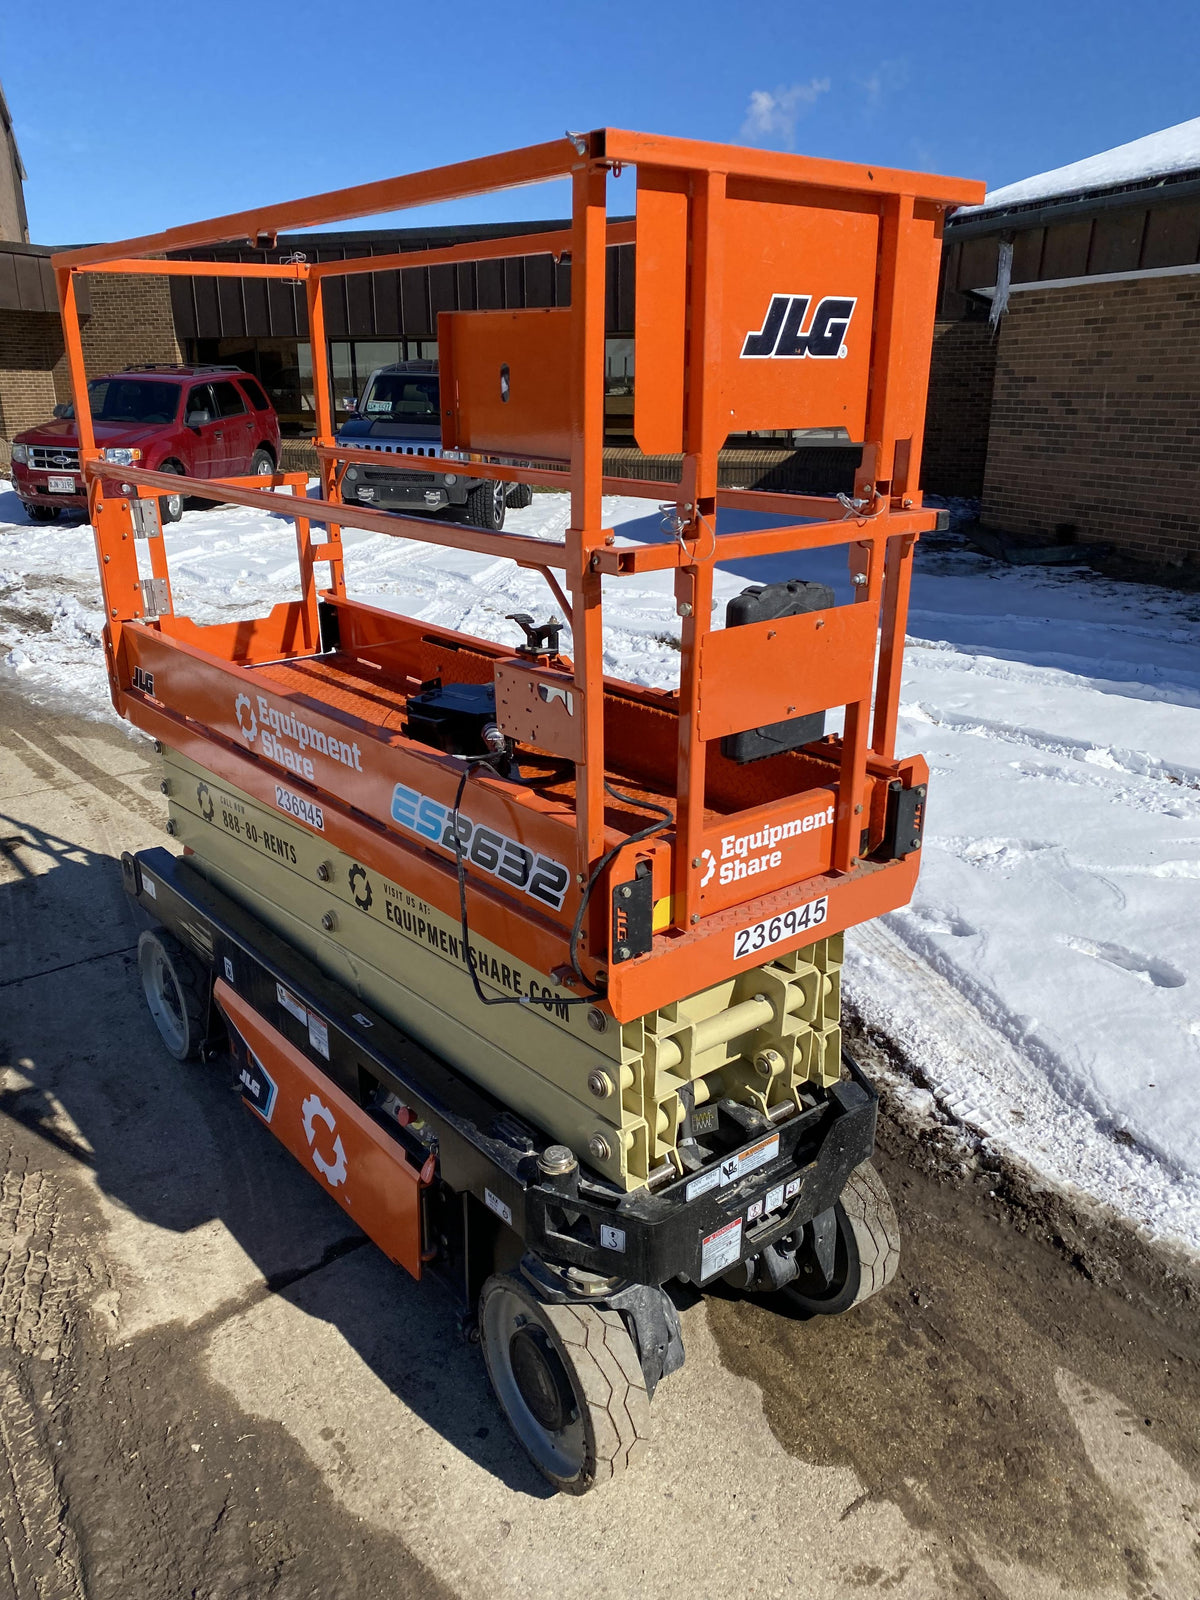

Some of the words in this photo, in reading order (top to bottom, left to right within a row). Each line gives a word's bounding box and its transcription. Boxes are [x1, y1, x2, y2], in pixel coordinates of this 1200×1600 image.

[740, 293, 857, 359] JLG
[132, 665, 155, 697] JLG
[257, 695, 362, 773] Equipment
[261, 729, 314, 780] Share
[220, 796, 232, 808] CALL
[276, 787, 324, 830] 236945
[222, 810, 297, 864] 888-80-RENTS
[392, 783, 570, 911] ES2632
[720, 805, 834, 861] Equipment
[719, 850, 782, 886] Share
[383, 883, 404, 902] VISIT
[406, 895, 416, 908] US
[419, 901, 431, 915] AT:
[617, 907, 627, 942] JLG
[735, 898, 827, 958] 236945
[240, 1069, 260, 1098] JLG
